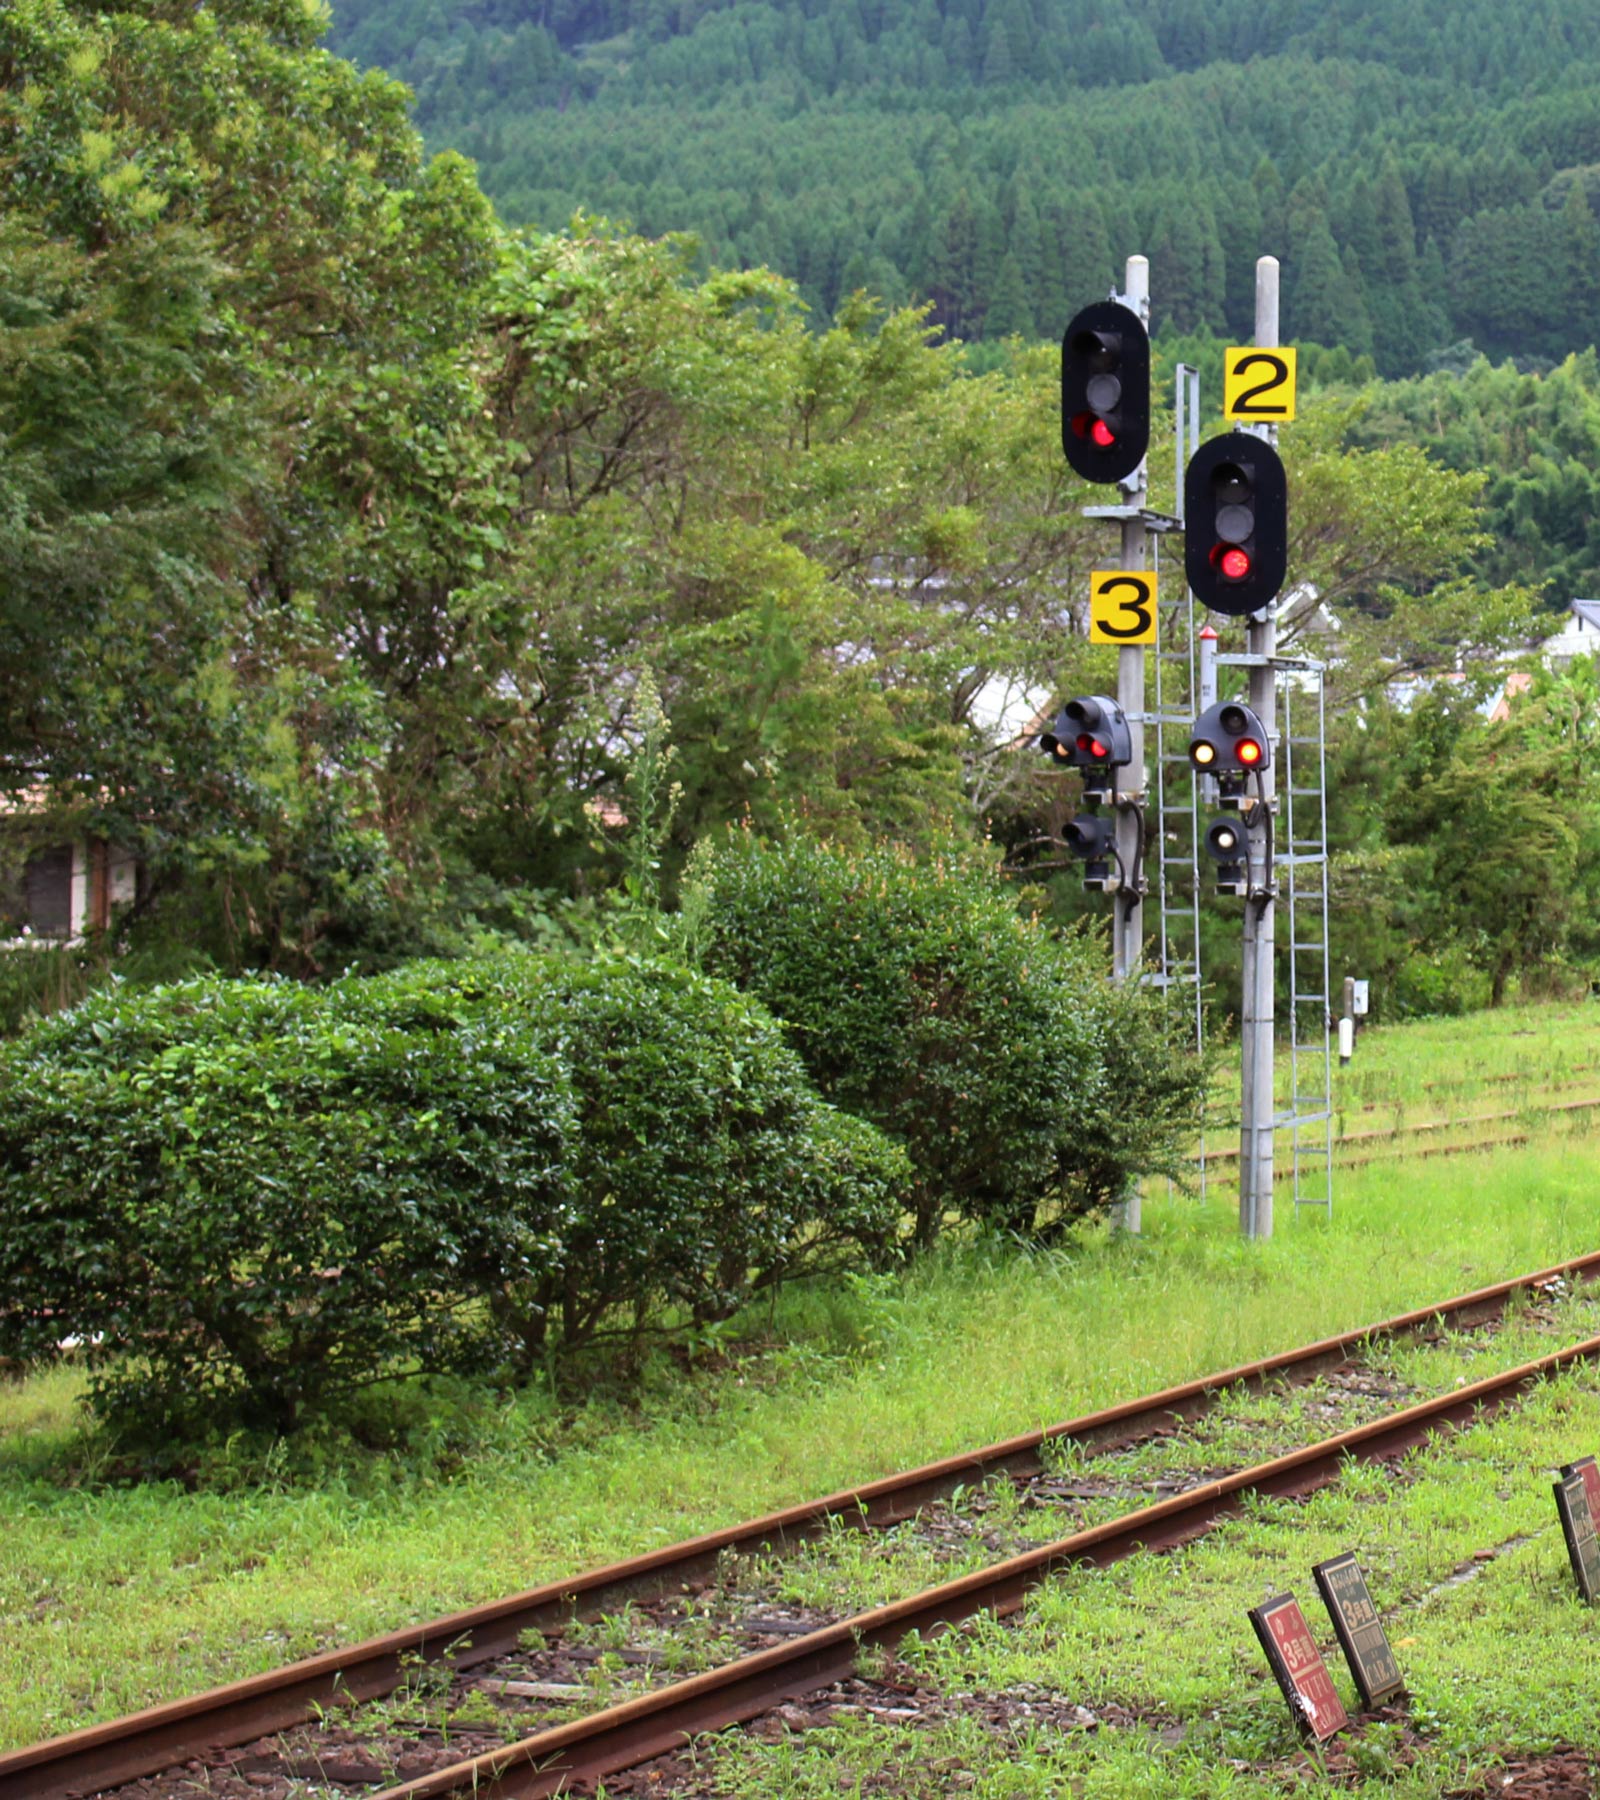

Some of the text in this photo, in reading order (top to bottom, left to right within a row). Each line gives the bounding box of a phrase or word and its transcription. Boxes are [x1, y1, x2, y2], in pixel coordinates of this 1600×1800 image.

[1231, 353, 1290, 415] 2
[1095, 576, 1153, 638] 3
[1341, 1598, 1374, 1628] 3号車
[1283, 1635, 1316, 1669] 3号車
